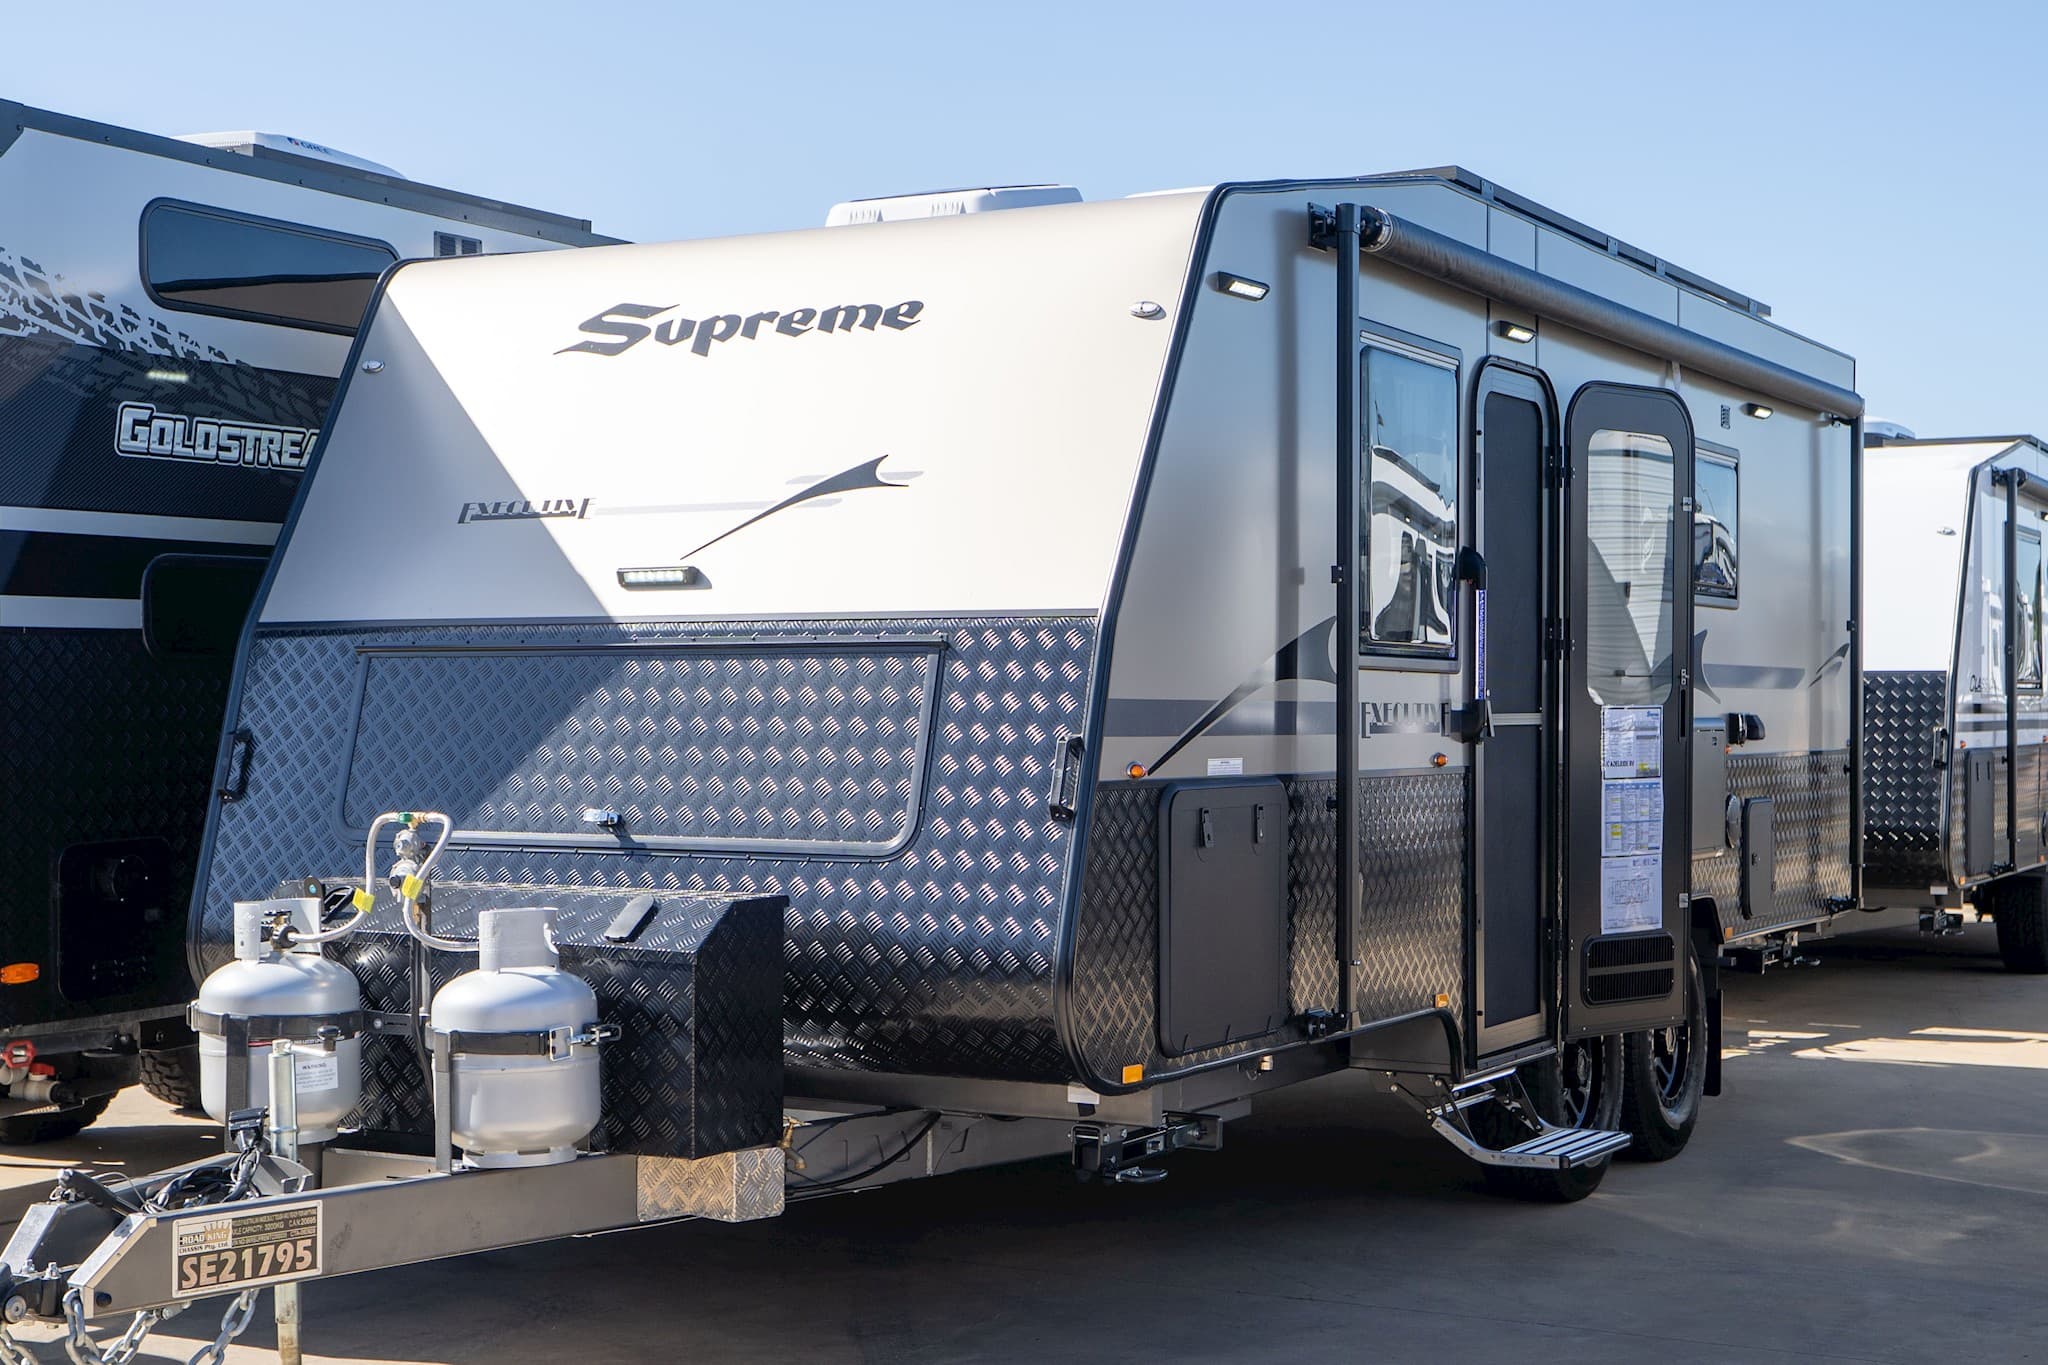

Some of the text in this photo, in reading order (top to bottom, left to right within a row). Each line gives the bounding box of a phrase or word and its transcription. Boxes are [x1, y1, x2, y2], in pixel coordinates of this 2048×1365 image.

[553, 300, 924, 357] Supreme
[457, 497, 597, 525] EXECUTIVE
[1361, 702, 1450, 739] EXECUTIVE
[179, 1245, 204, 1254] CHASSIS
[183, 1233, 205, 1246] ROAD
[206, 1230, 228, 1242] KING
[181, 1238, 313, 1289] SE21795
